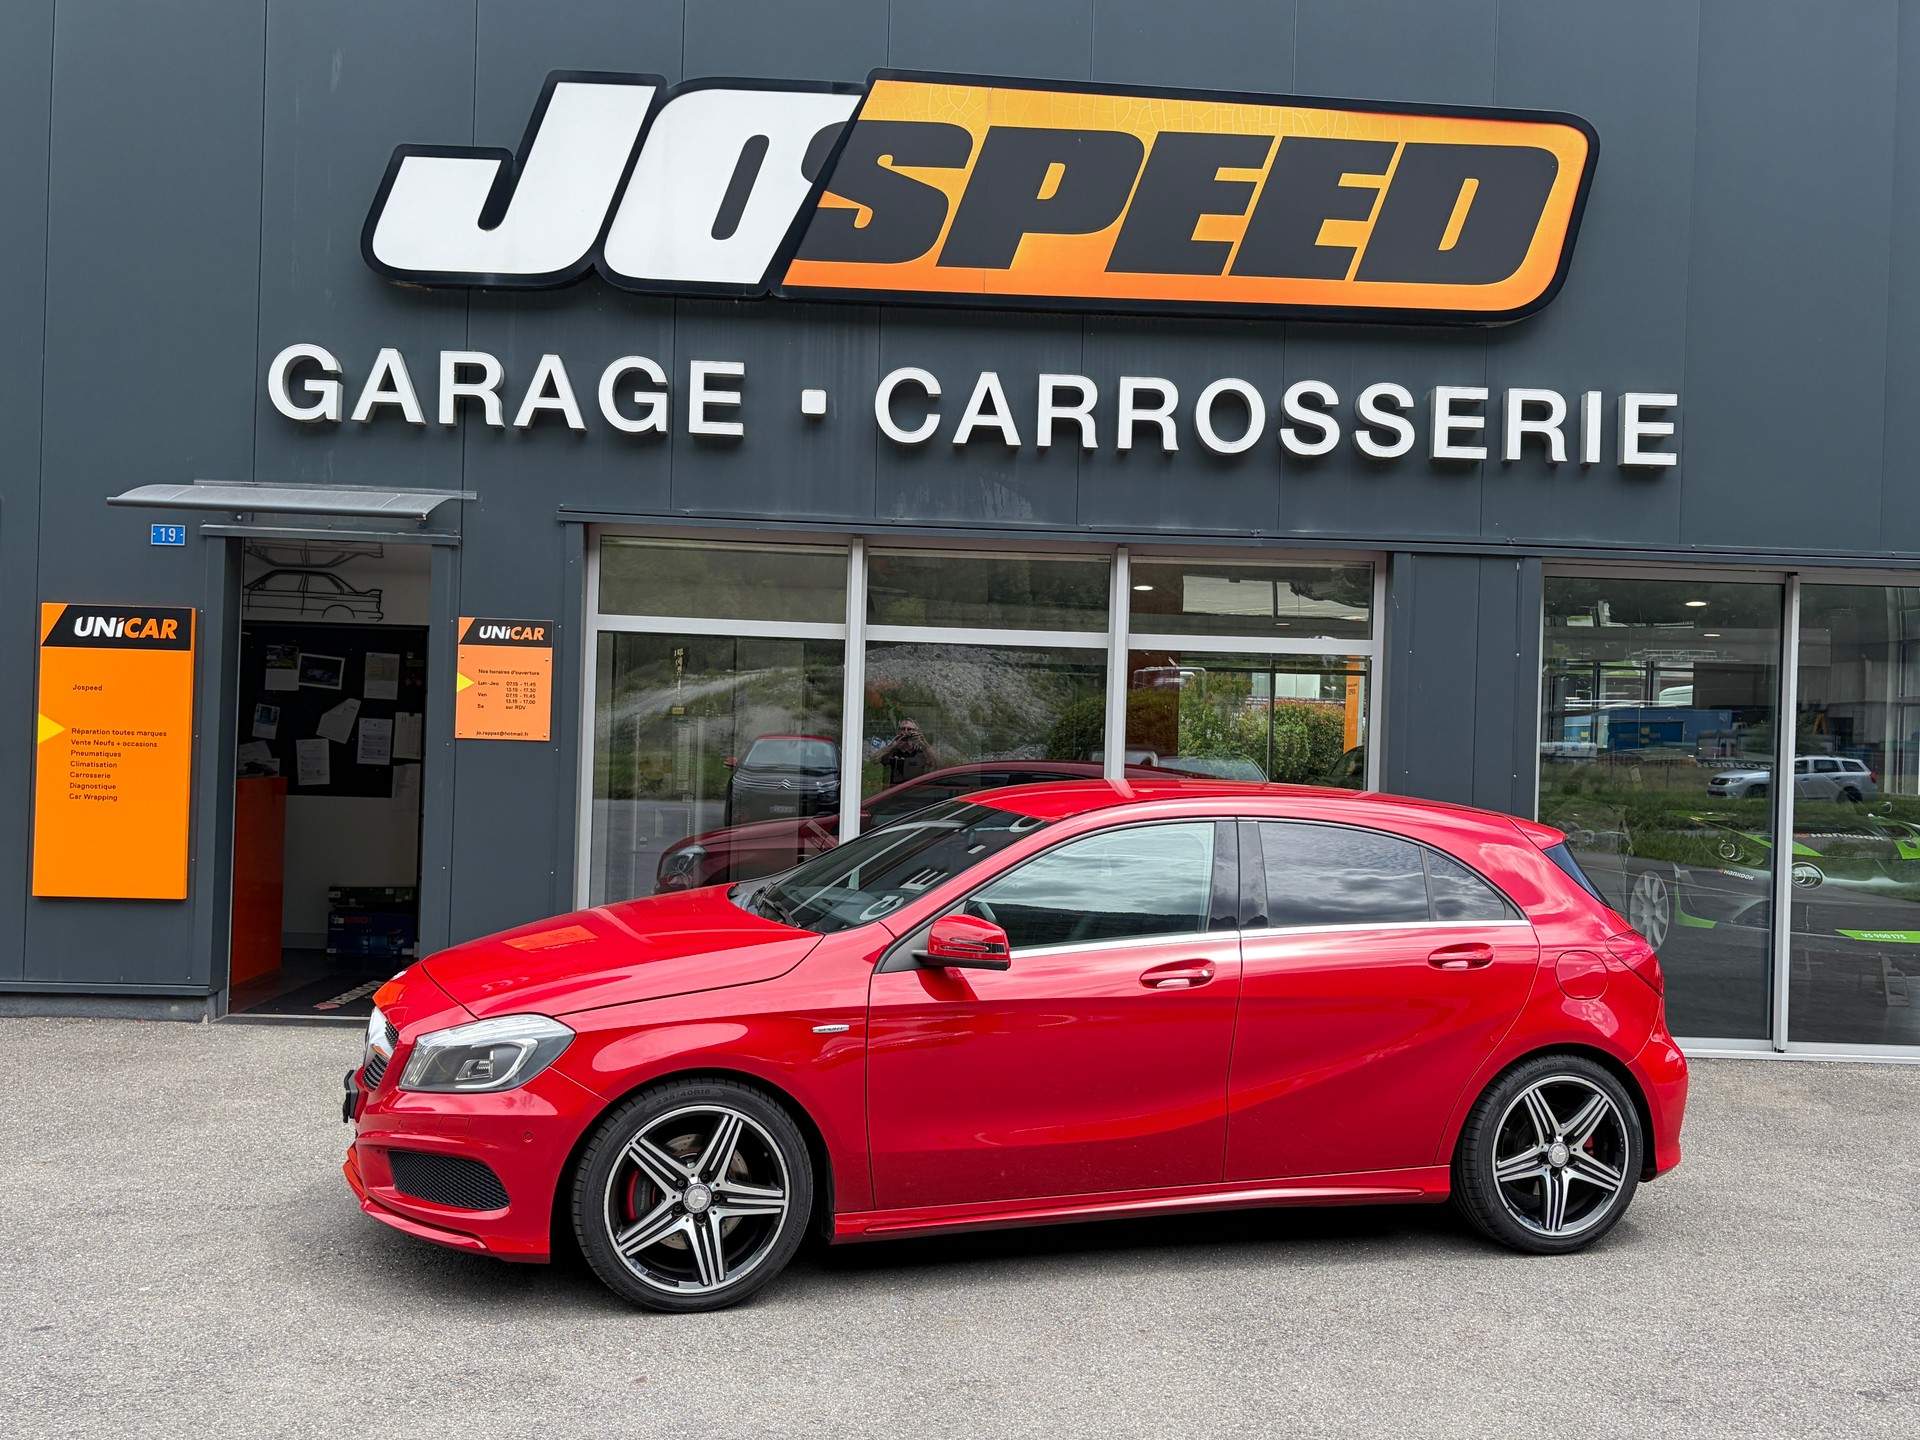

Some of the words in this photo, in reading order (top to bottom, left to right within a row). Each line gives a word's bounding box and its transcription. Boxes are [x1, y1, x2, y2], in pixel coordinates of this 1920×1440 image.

[266, 343, 746, 438] GARAGE
[874, 366, 1679, 468] CARROSSERIE
[160, 527, 176, 542] 19
[72, 728, 110, 736] Réparation
[70, 750, 122, 758] Pneumatiques
[70, 782, 116, 790] Diagnostique
[84, 794, 118, 802] Wrapping
